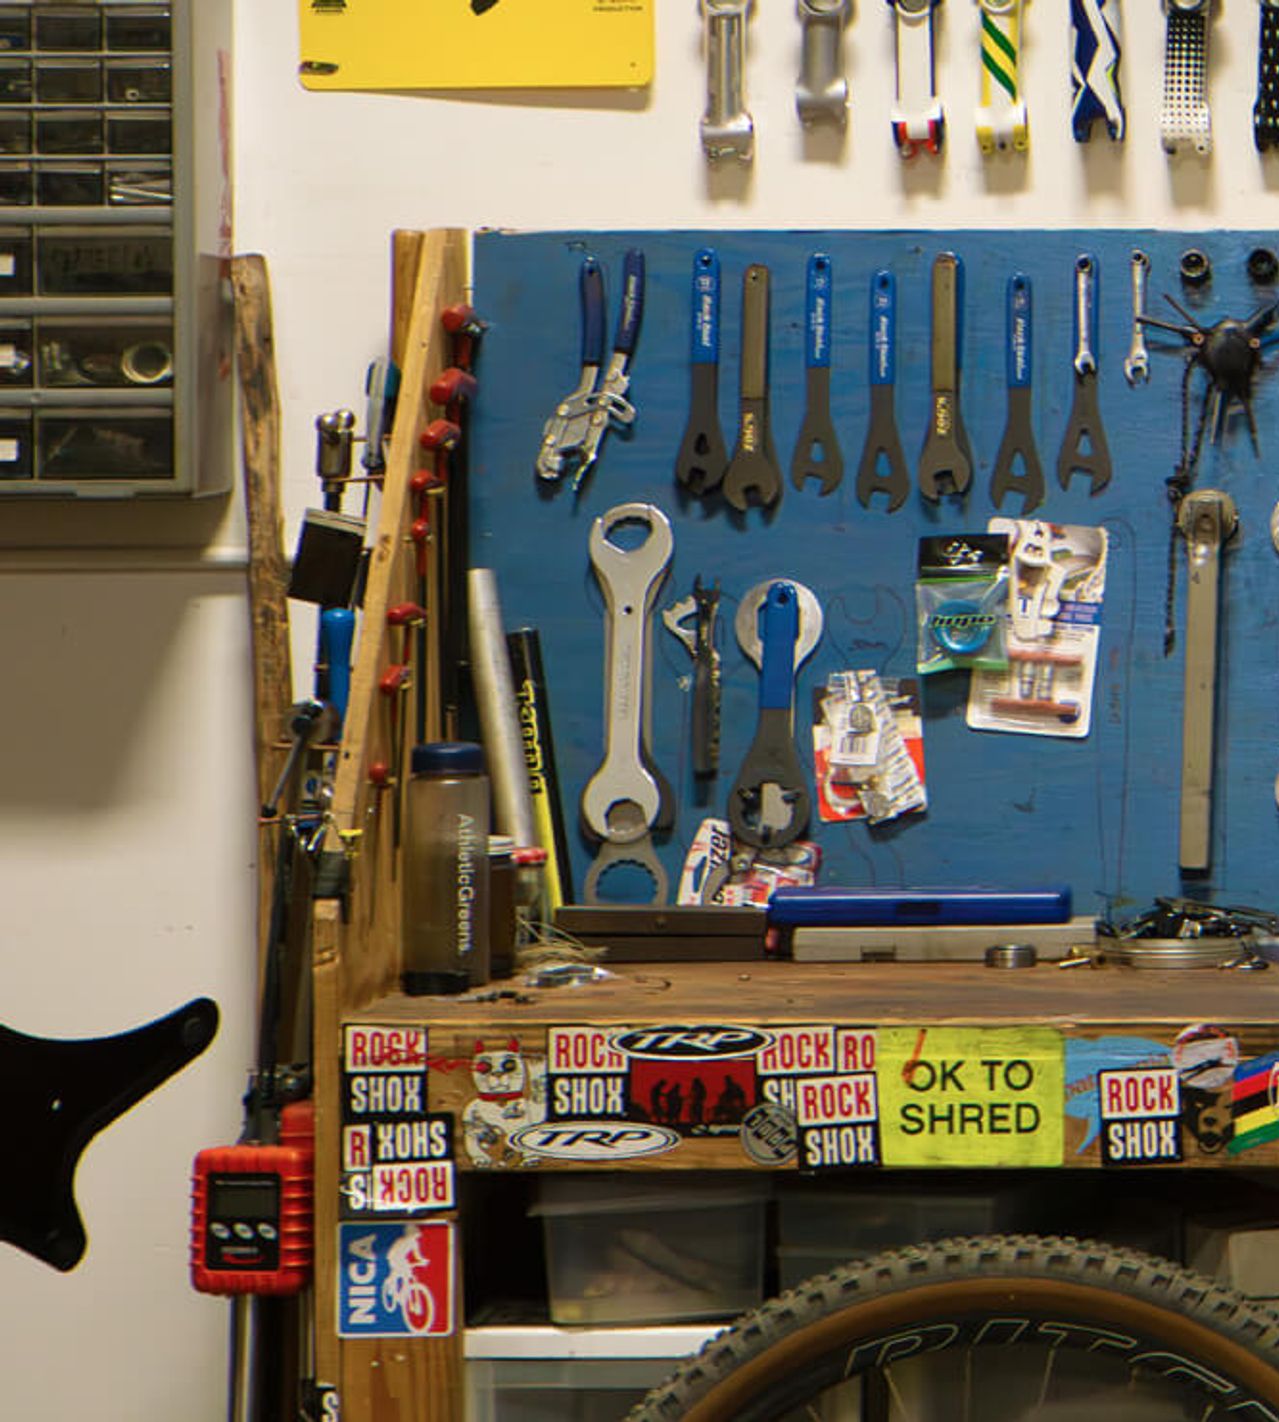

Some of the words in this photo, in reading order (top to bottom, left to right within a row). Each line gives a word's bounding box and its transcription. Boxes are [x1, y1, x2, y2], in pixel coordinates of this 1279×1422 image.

[352, 1028, 421, 1067] ROCK
[625, 1029, 749, 1051] TRP
[844, 1034, 876, 1071] RO
[351, 1076, 422, 1114] SHOX
[908, 1060, 965, 1093] OK
[981, 1060, 1034, 1092] TO
[1107, 1073, 1175, 1113] ROCK
[554, 1078, 625, 1116] SHOX
[803, 1081, 872, 1120] ROCK
[900, 1103, 1041, 1135] SHRED
[377, 1121, 447, 1160] SHOX
[537, 1130, 652, 1148] TRP
[806, 1129, 876, 1167] SHOX
[1108, 1122, 1178, 1161] SHOX
[380, 1166, 447, 1204] ROCK
[348, 1233, 379, 1325] NICA
